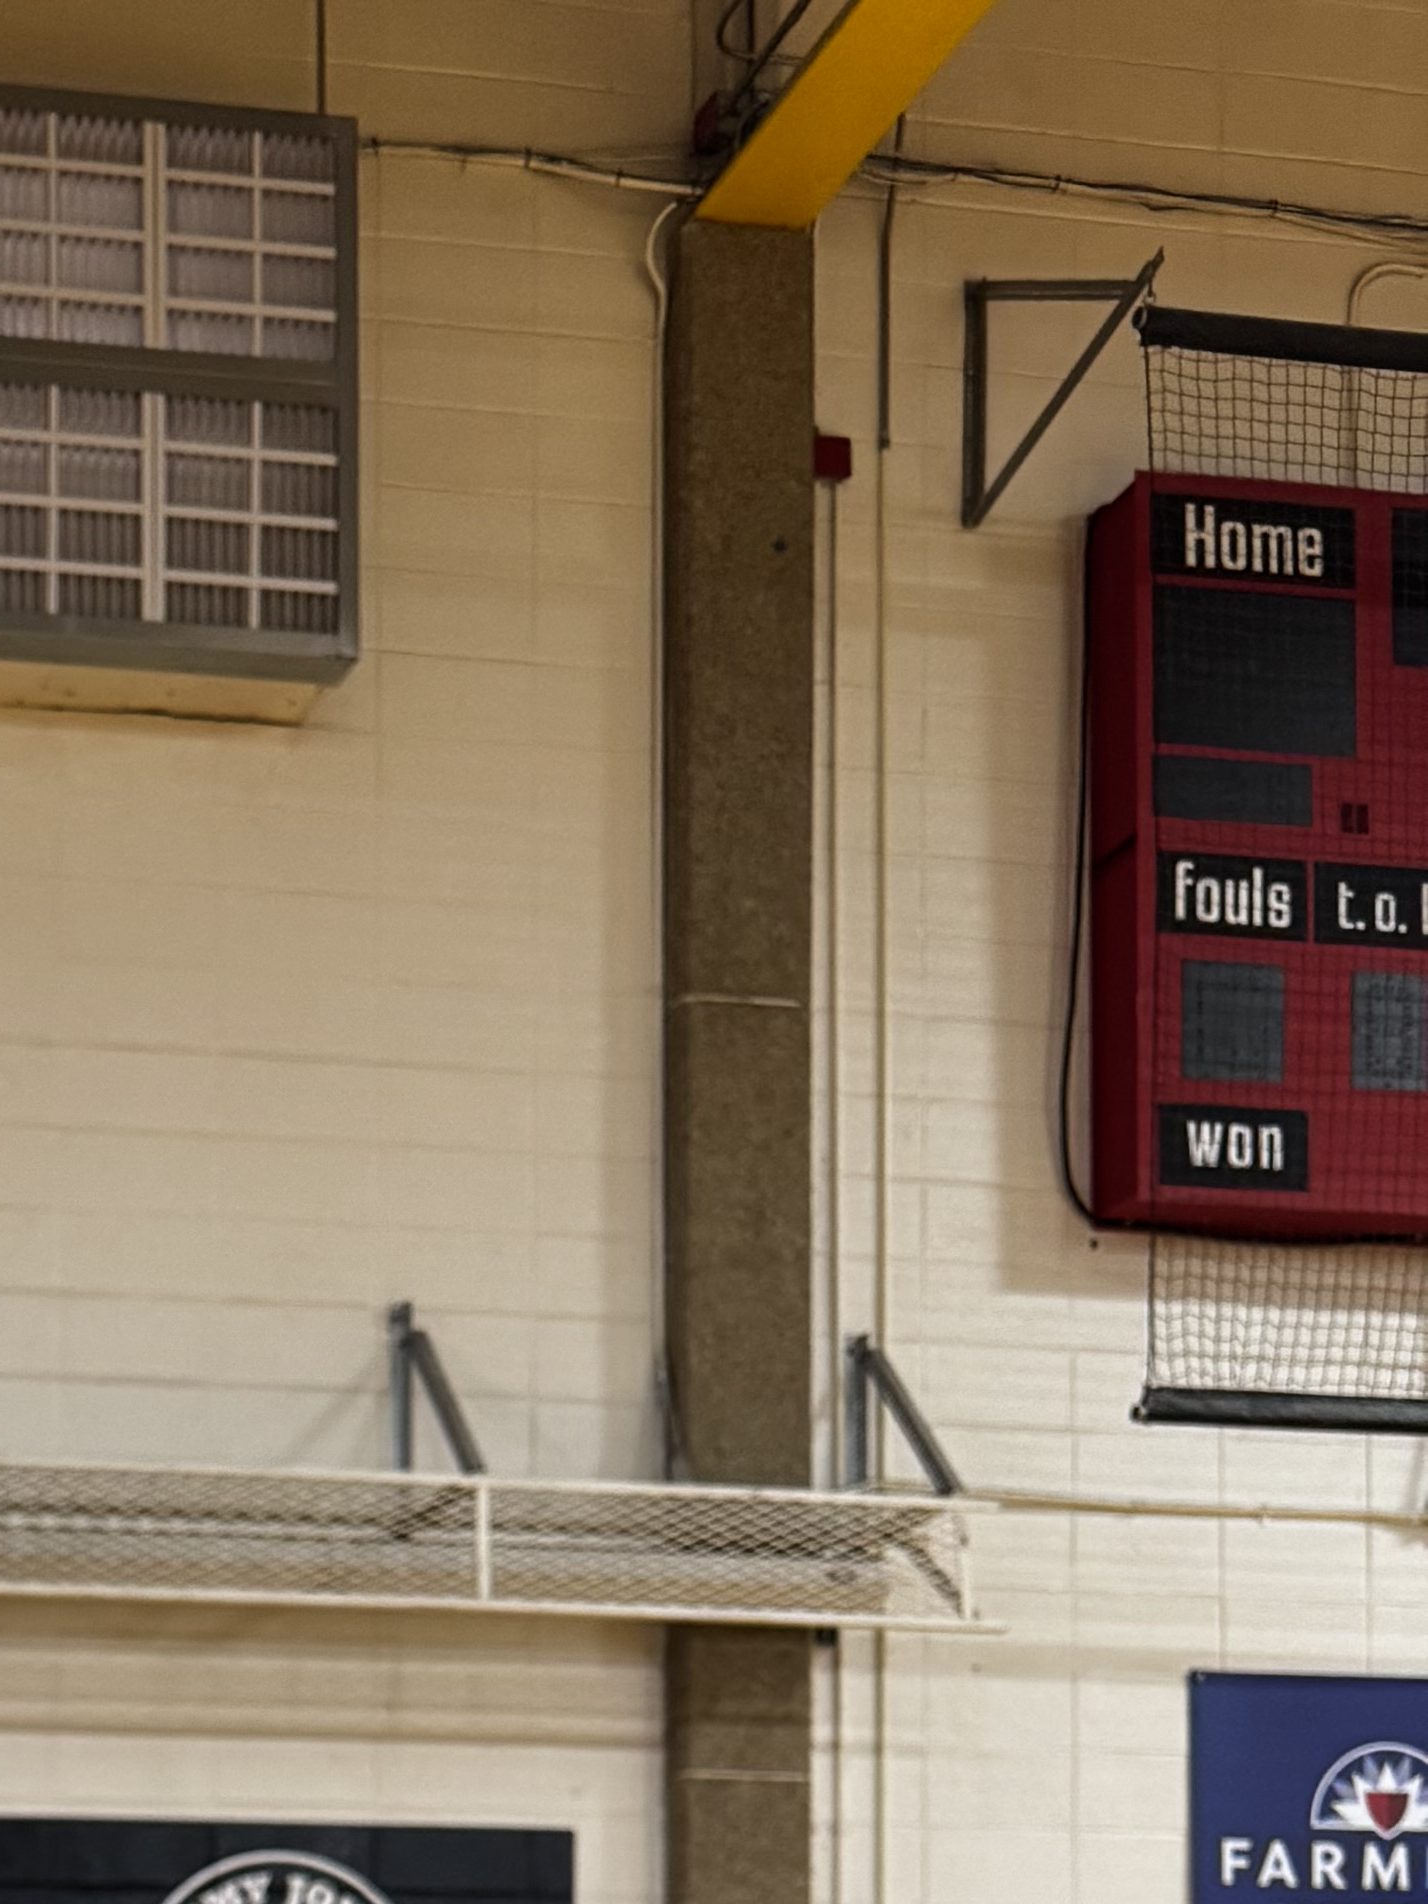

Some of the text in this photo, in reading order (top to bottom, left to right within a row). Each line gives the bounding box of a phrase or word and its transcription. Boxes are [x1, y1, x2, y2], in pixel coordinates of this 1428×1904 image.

[1184, 503, 1325, 577] Home
[1173, 860, 1293, 929] fouls
[1185, 1119, 1285, 1172] won
[1220, 1836, 1428, 1892] FARM
